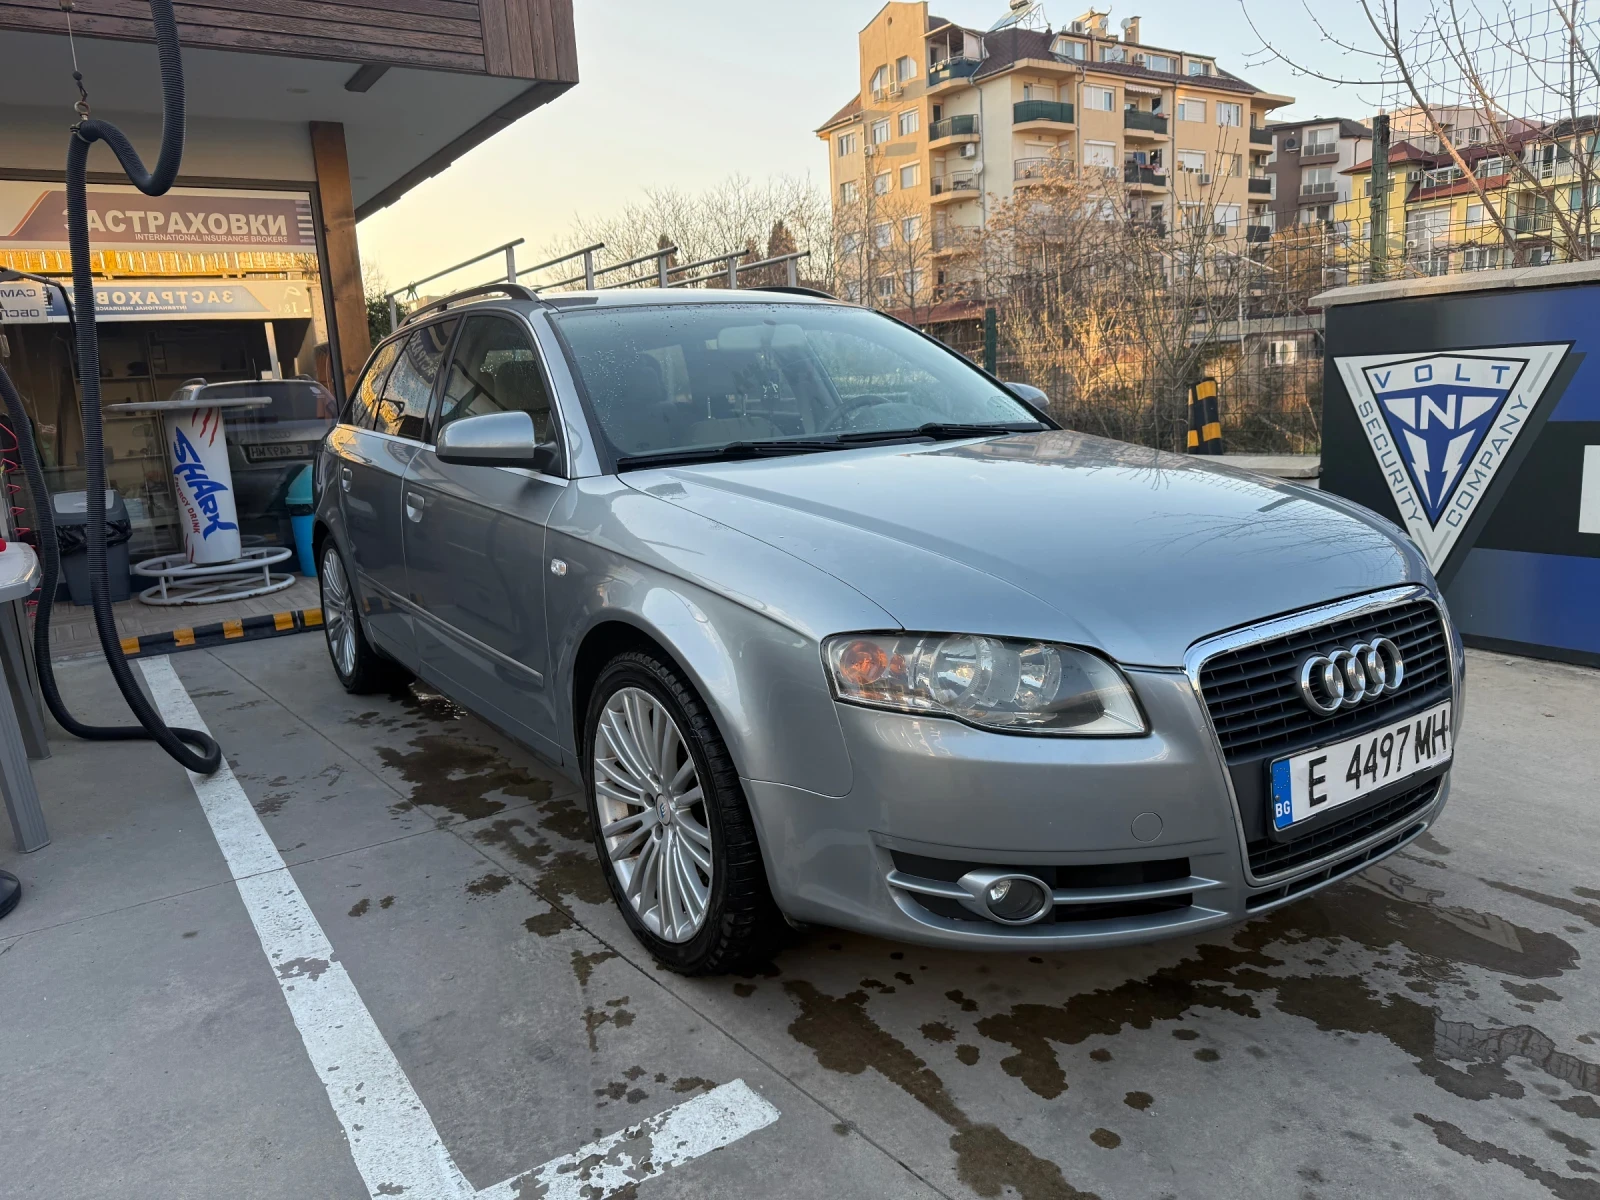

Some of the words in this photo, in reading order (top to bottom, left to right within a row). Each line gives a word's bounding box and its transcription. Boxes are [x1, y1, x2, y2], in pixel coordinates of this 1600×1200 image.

[62, 209, 287, 235] АСТРАХОВКИ
[135, 233, 202, 242] INTERNATIONAL
[202, 235, 250, 243] INSURANCE
[250, 235, 288, 243] BROKERS
[1373, 362, 1511, 389] VOLT
[173, 426, 239, 542] SHARK
[1358, 399, 1423, 522] SECURITY
[1445, 393, 1529, 528] COMPANY
[174, 476, 191, 507] ENERGY
[187, 507, 201, 534] DRINK
[1308, 755, 1328, 808] E
[1345, 724, 1411, 790] 4497
[1414, 709, 1448, 764] MH
[1275, 801, 1292, 818] BG
